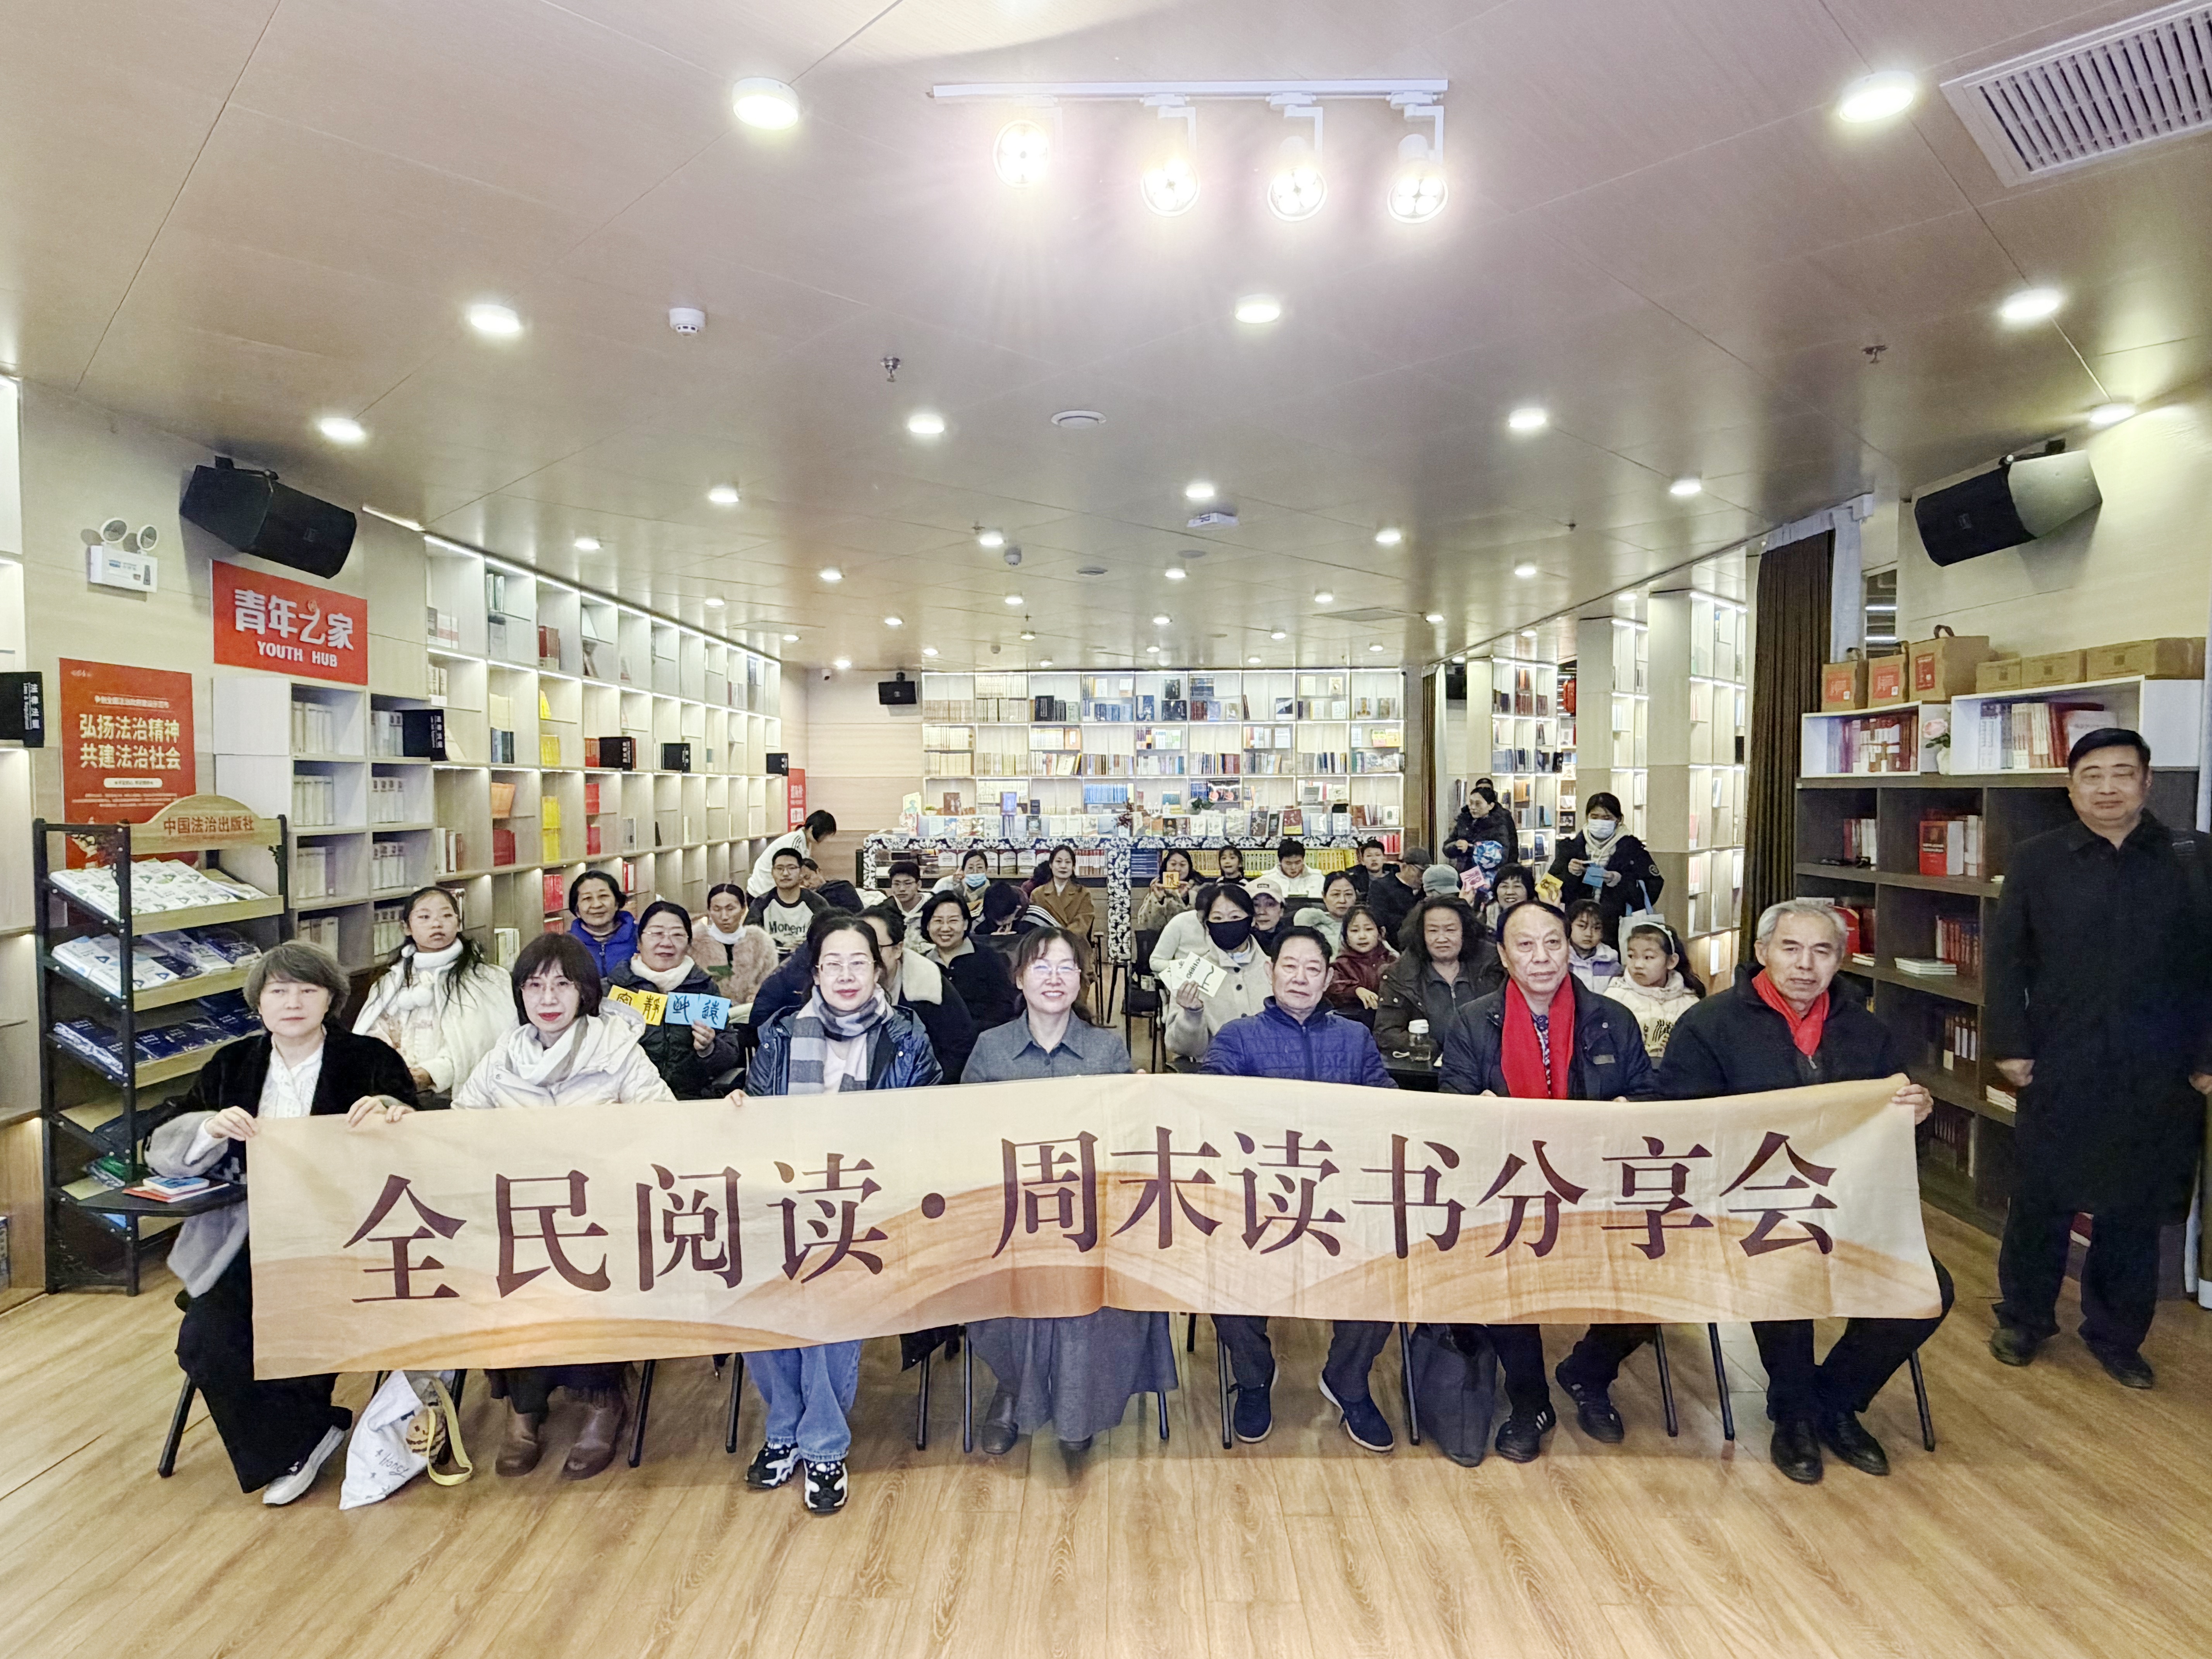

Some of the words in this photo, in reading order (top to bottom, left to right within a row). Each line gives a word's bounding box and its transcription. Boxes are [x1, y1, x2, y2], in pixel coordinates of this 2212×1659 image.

[234, 589, 354, 651] 青年之家
[257, 641, 303, 662] YOUTH
[312, 651, 338, 667] HUB
[79, 713, 180, 743] 弘扬法治精神
[80, 744, 181, 770] 共建法治社会
[163, 816, 255, 835] 中国法治出版社
[379, 1453, 411, 1478] Honey
